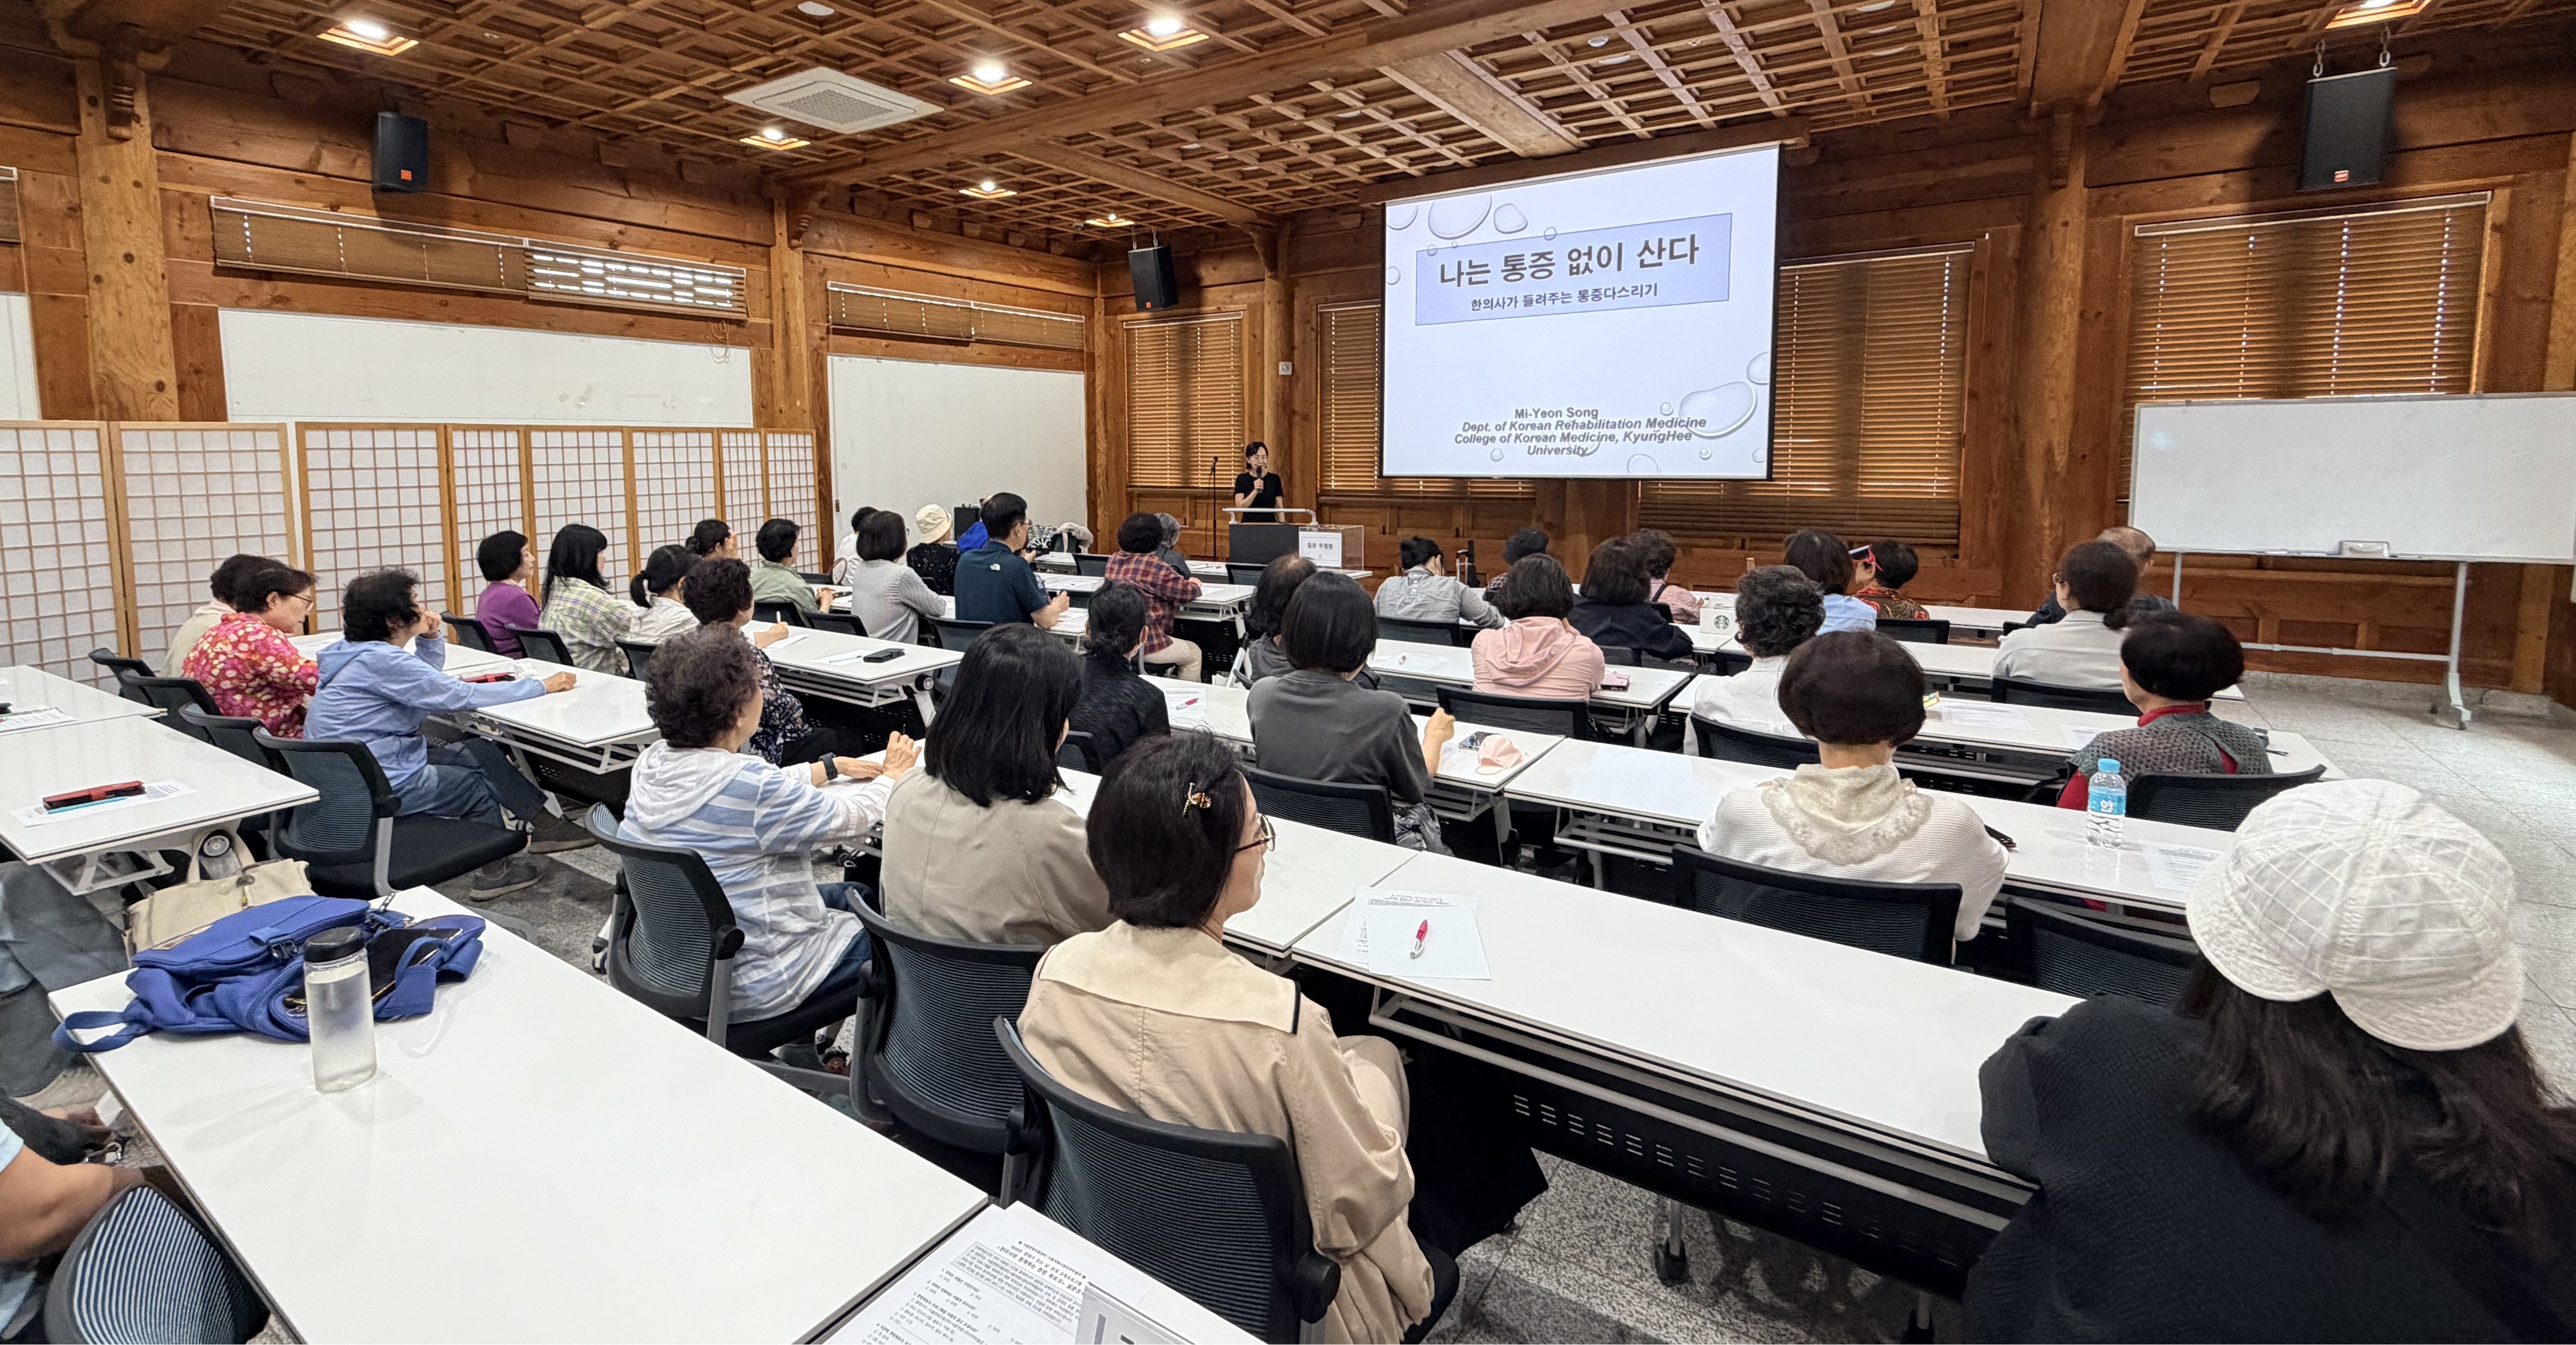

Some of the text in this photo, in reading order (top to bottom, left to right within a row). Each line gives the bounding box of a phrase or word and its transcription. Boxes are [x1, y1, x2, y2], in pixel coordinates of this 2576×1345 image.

[1440, 234, 1699, 287] 나는 통증 없이 산다
[1471, 283, 1657, 311] 한의사가 들려주는 통증다스리기
[1514, 407, 1599, 420] Mi-Yeon Song
[1462, 417, 1707, 434] Dept. of Korean Rehabilitation Medicine
[1454, 431, 1693, 446] College of Korean Medicine, KyungHee
[1527, 445, 1588, 457] University
